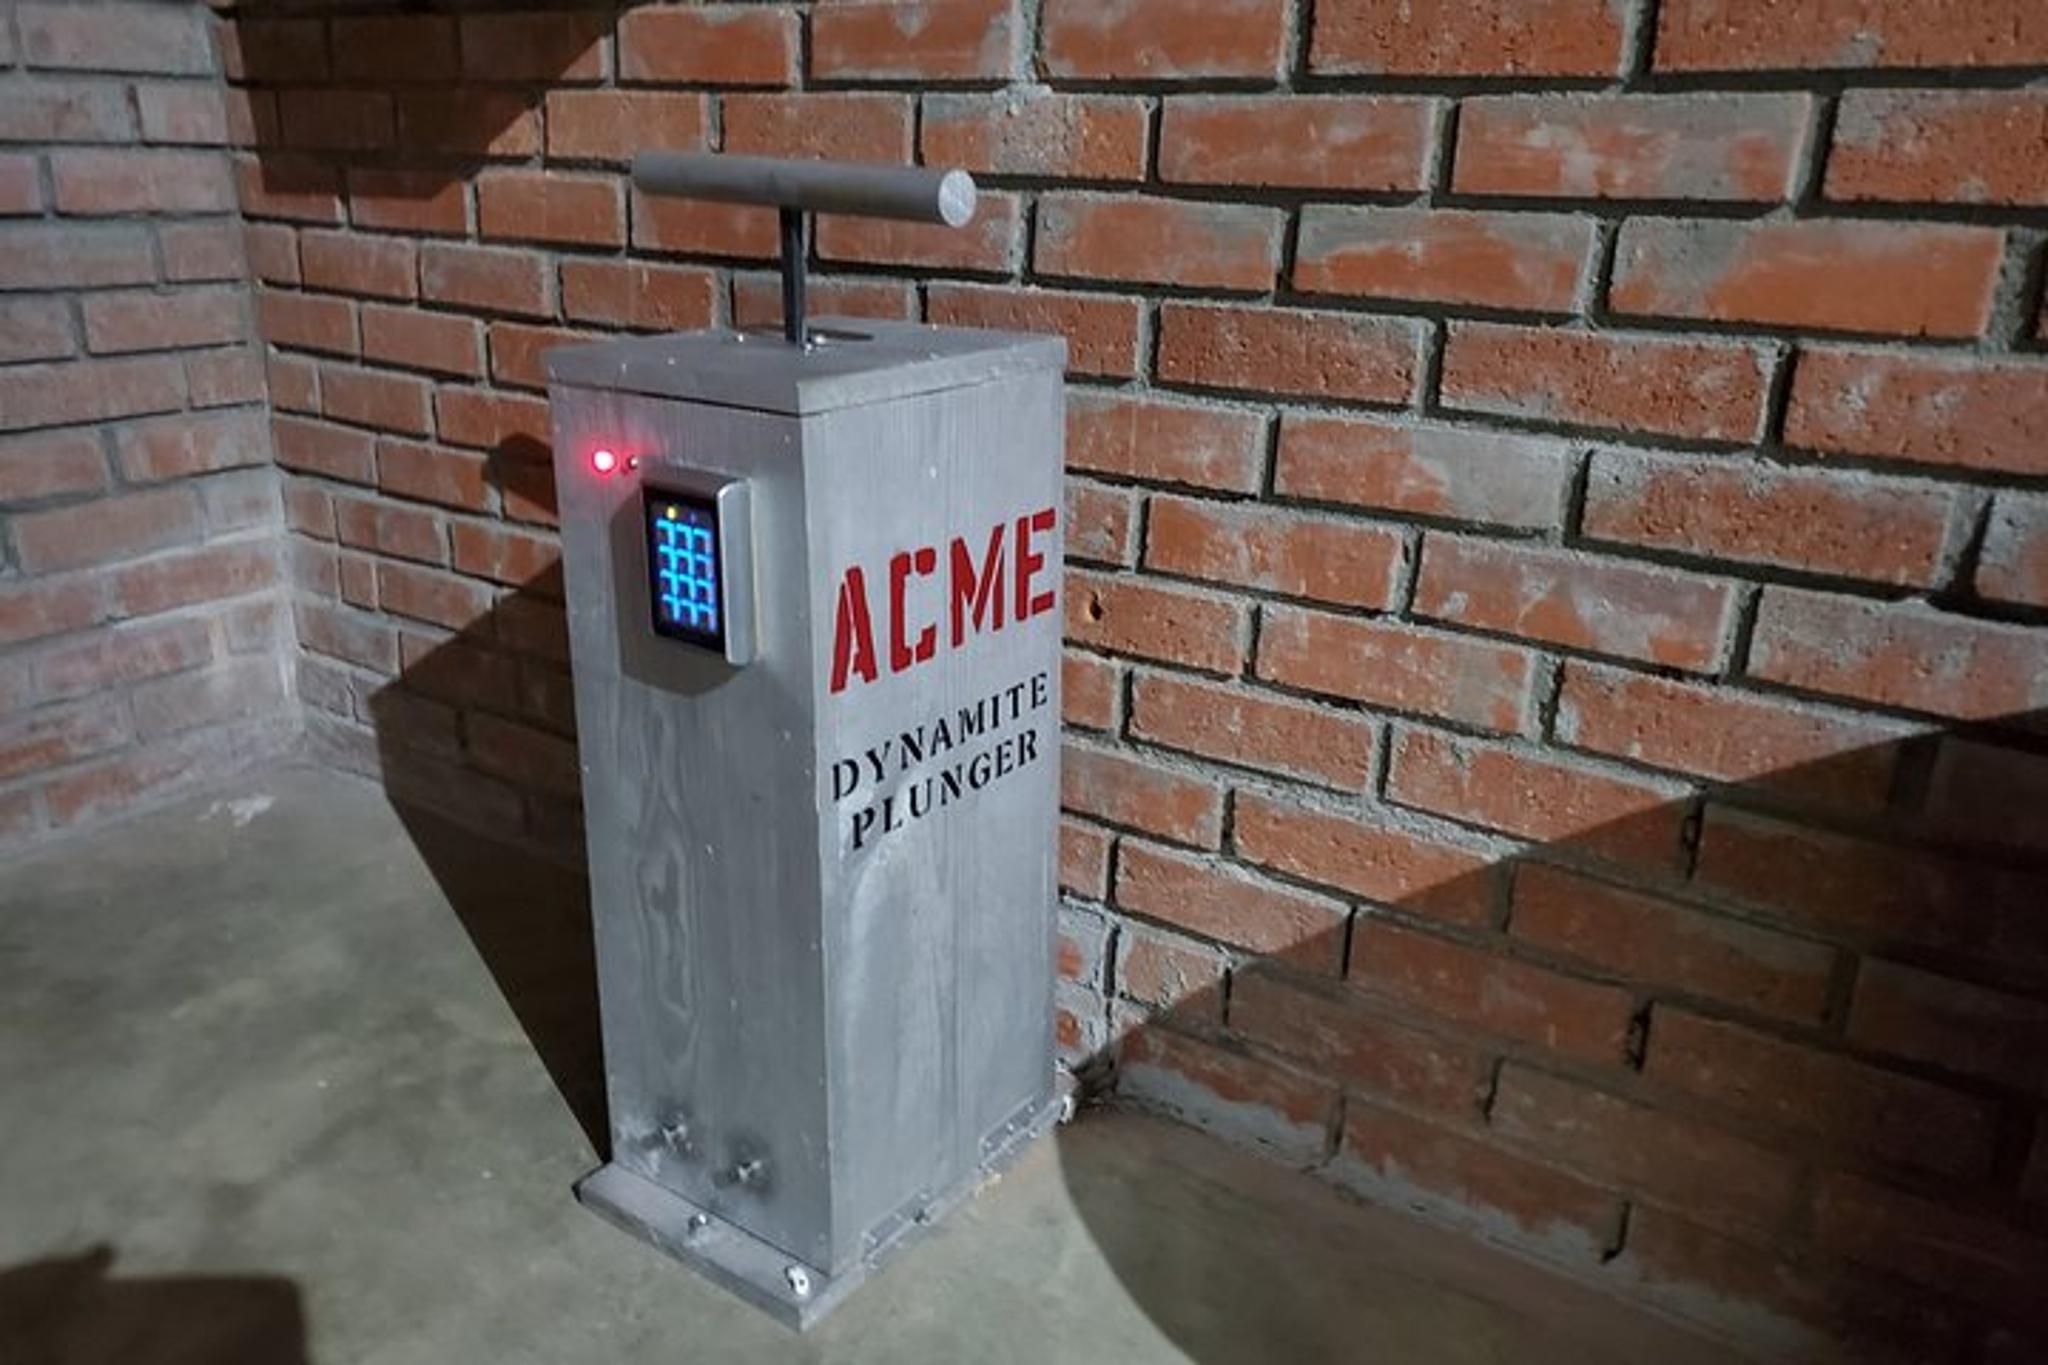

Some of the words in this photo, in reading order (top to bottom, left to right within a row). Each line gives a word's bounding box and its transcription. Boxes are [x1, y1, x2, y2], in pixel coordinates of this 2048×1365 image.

[830, 507, 1056, 694] ACME
[832, 673, 1048, 801] DYNAMITE
[852, 729, 1038, 850] PLUNGER
